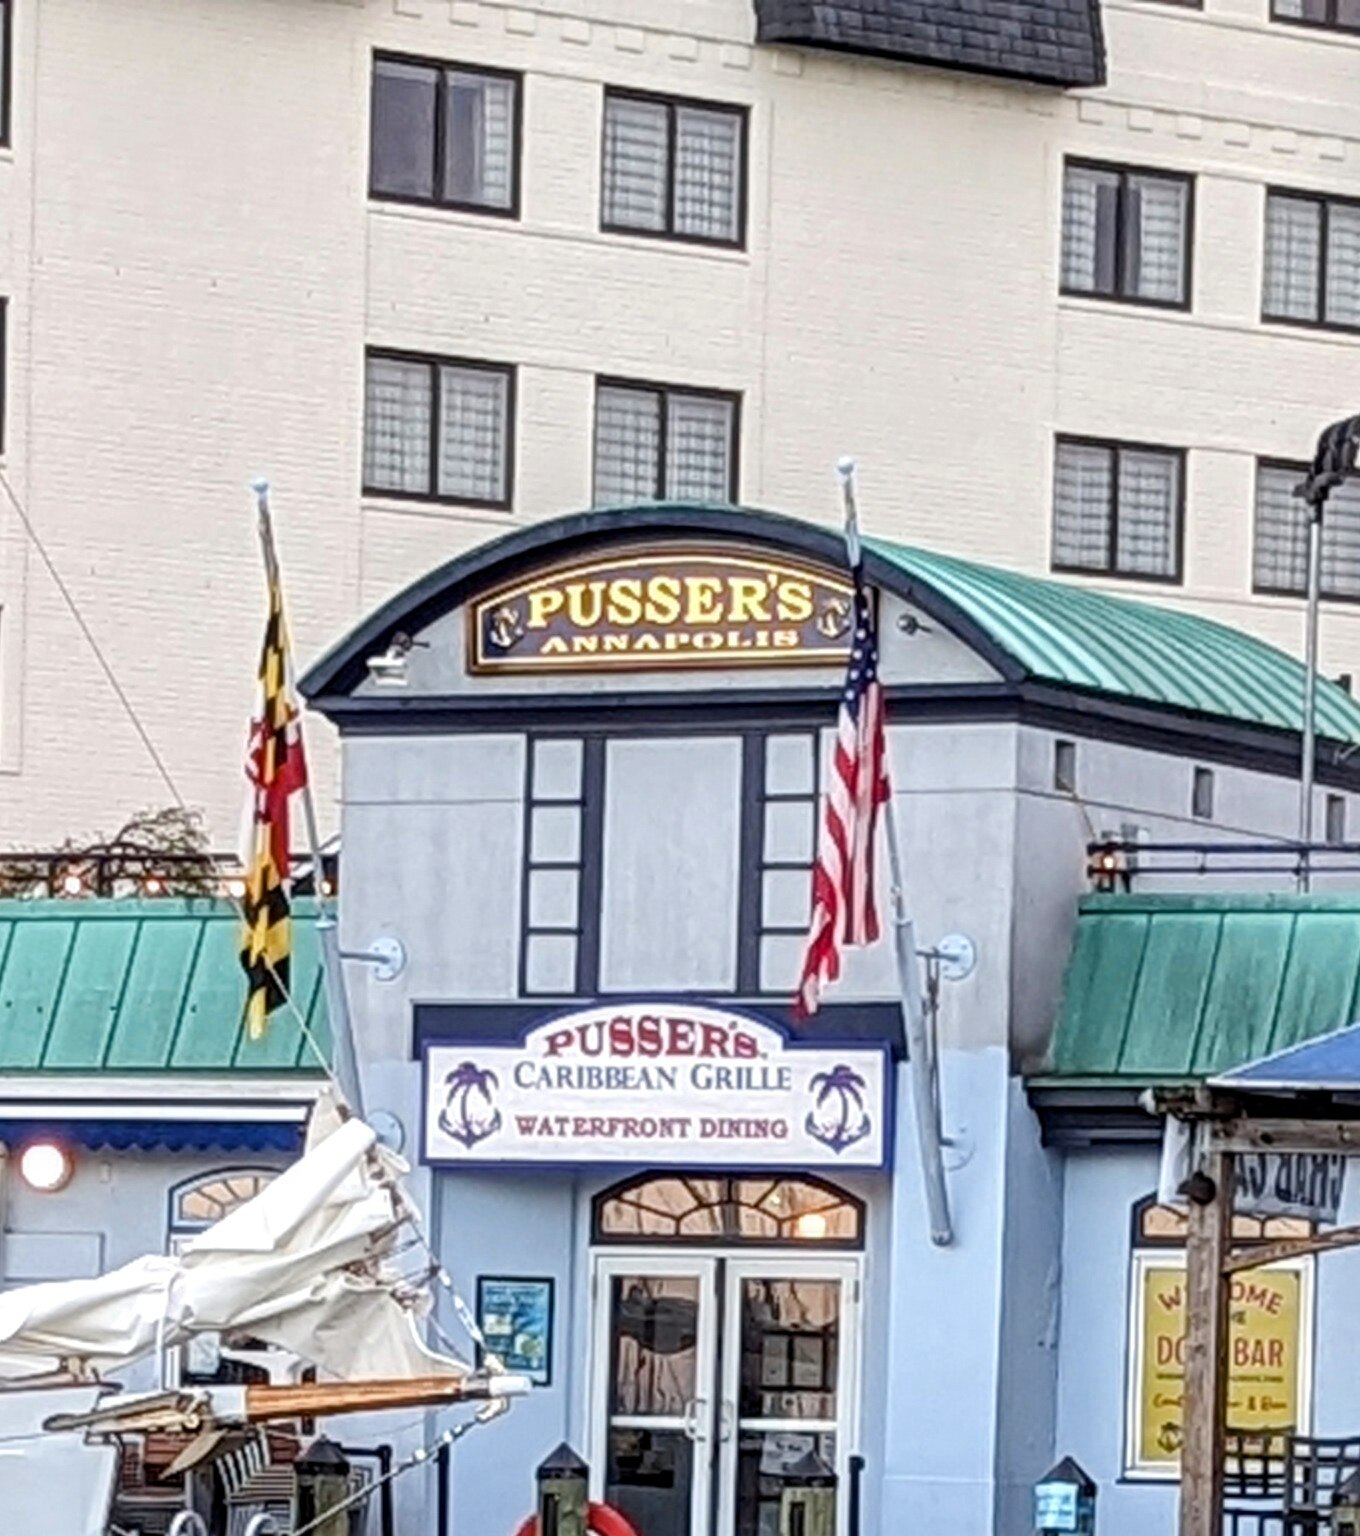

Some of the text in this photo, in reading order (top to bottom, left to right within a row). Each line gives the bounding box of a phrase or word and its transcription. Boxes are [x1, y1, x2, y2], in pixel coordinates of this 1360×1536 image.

[527, 574, 814, 629] PUSSER'S
[540, 629, 800, 655] ANNAPOLIS
[514, 1115, 789, 1139] WATERFRONT DINING
[1157, 1281, 1284, 1316] WOME
[1233, 1337, 1284, 1367] BAR
